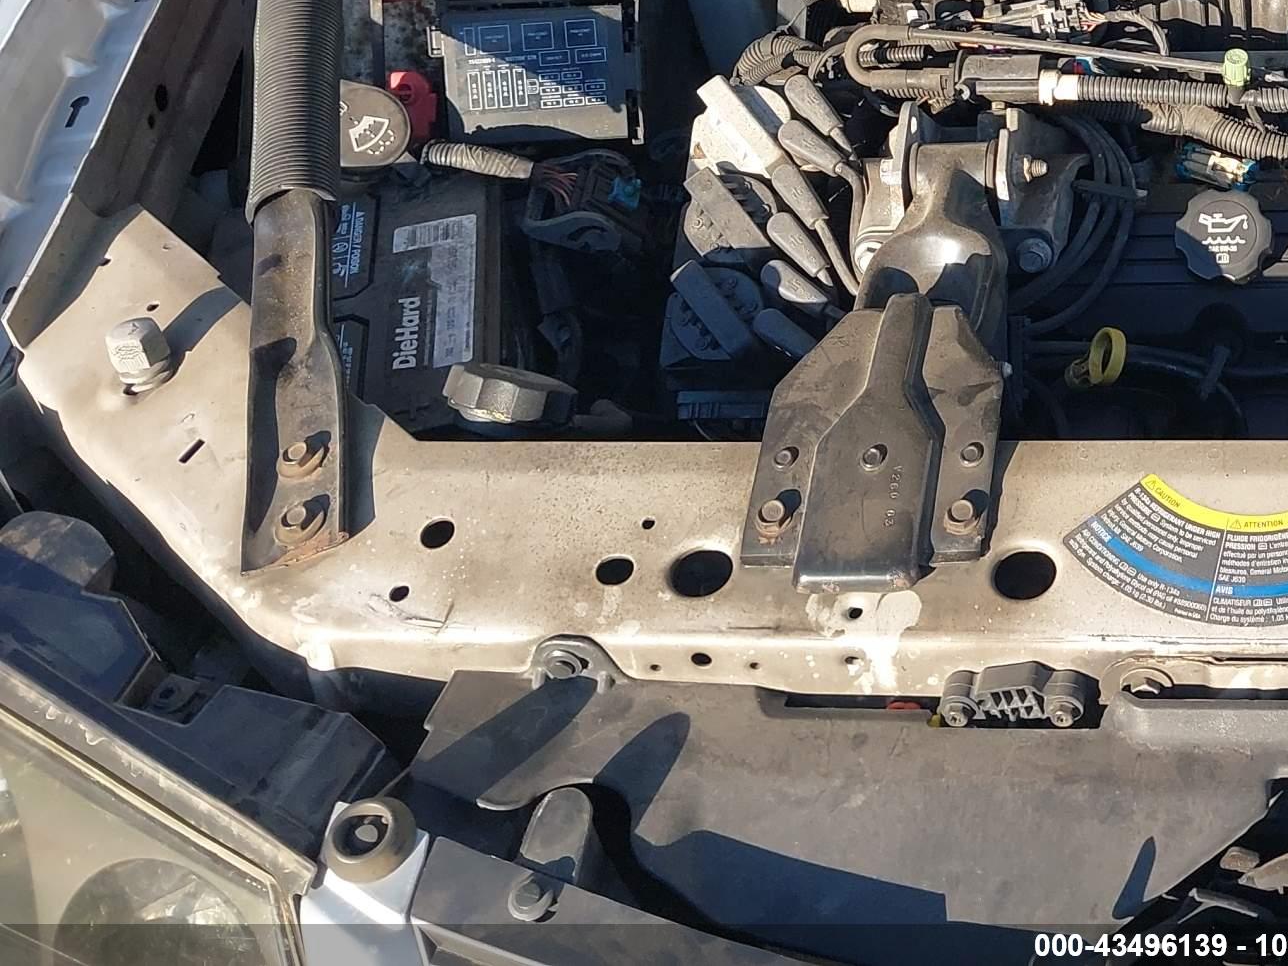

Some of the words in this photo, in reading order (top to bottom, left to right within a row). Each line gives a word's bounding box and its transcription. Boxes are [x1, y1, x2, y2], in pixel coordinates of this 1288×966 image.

[352, 217, 365, 243] DANGER
[349, 249, 361, 274] POISON
[392, 296, 422, 371] DieHard
[1155, 487, 1181, 508] CAUTION
[1128, 493, 1152, 515] PRESSURE
[1160, 519, 1179, 533] System
[1179, 527, 1185, 535] to
[1186, 529, 1193, 539] be
[1193, 533, 1216, 546] serviced
[1134, 488, 1150, 504] R-134a
[1150, 502, 1185, 527] REFRIGERANT
[1184, 520, 1205, 534] UNDER
[1205, 529, 1221, 538] HIGH
[1244, 519, 1283, 528] ATTENTION
[1090, 520, 1112, 543] NOTICE
[1119, 520, 1137, 539] General
[1136, 535, 1152, 547] Motors
[1126, 501, 1146, 523] qualified
[1143, 518, 1168, 540] personnel
[1179, 538, 1204, 552] Improper
[1120, 533, 1132, 544] SAE
[1130, 540, 1144, 551] J639
[1128, 517, 1148, 534] methods
[1147, 531, 1159, 542] may
[1158, 539, 1174, 550] cause
[1173, 545, 1198, 559] personal
[1225, 542, 1256, 550] PRESSION
[1227, 534, 1248, 542] FLUIDE
[1082, 529, 1091, 538] AIR
[1089, 535, 1120, 566] CONDITIONING
[1138, 573, 1150, 583] Use
[1148, 578, 1159, 588] only
[1159, 584, 1180, 596] R-134a
[1222, 559, 1249, 567] méthodes
[1251, 558, 1282, 567] d'entretien
[1247, 551, 1257, 559] par
[1086, 557, 1103, 574] System
[1139, 593, 1154, 604] (2.30
[1102, 558, 1131, 583] Polyalkylene
[1131, 579, 1146, 591] Glycol
[1231, 575, 1246, 583] J639
[1215, 586, 1233, 595] AVIS
[1212, 605, 1217, 613] et
[1227, 606, 1245, 615] l'huile
[1213, 598, 1252, 607] CLIMATISEUR
[1210, 614, 1230, 623] Charge
[1271, 614, 1284, 622] 1.05
